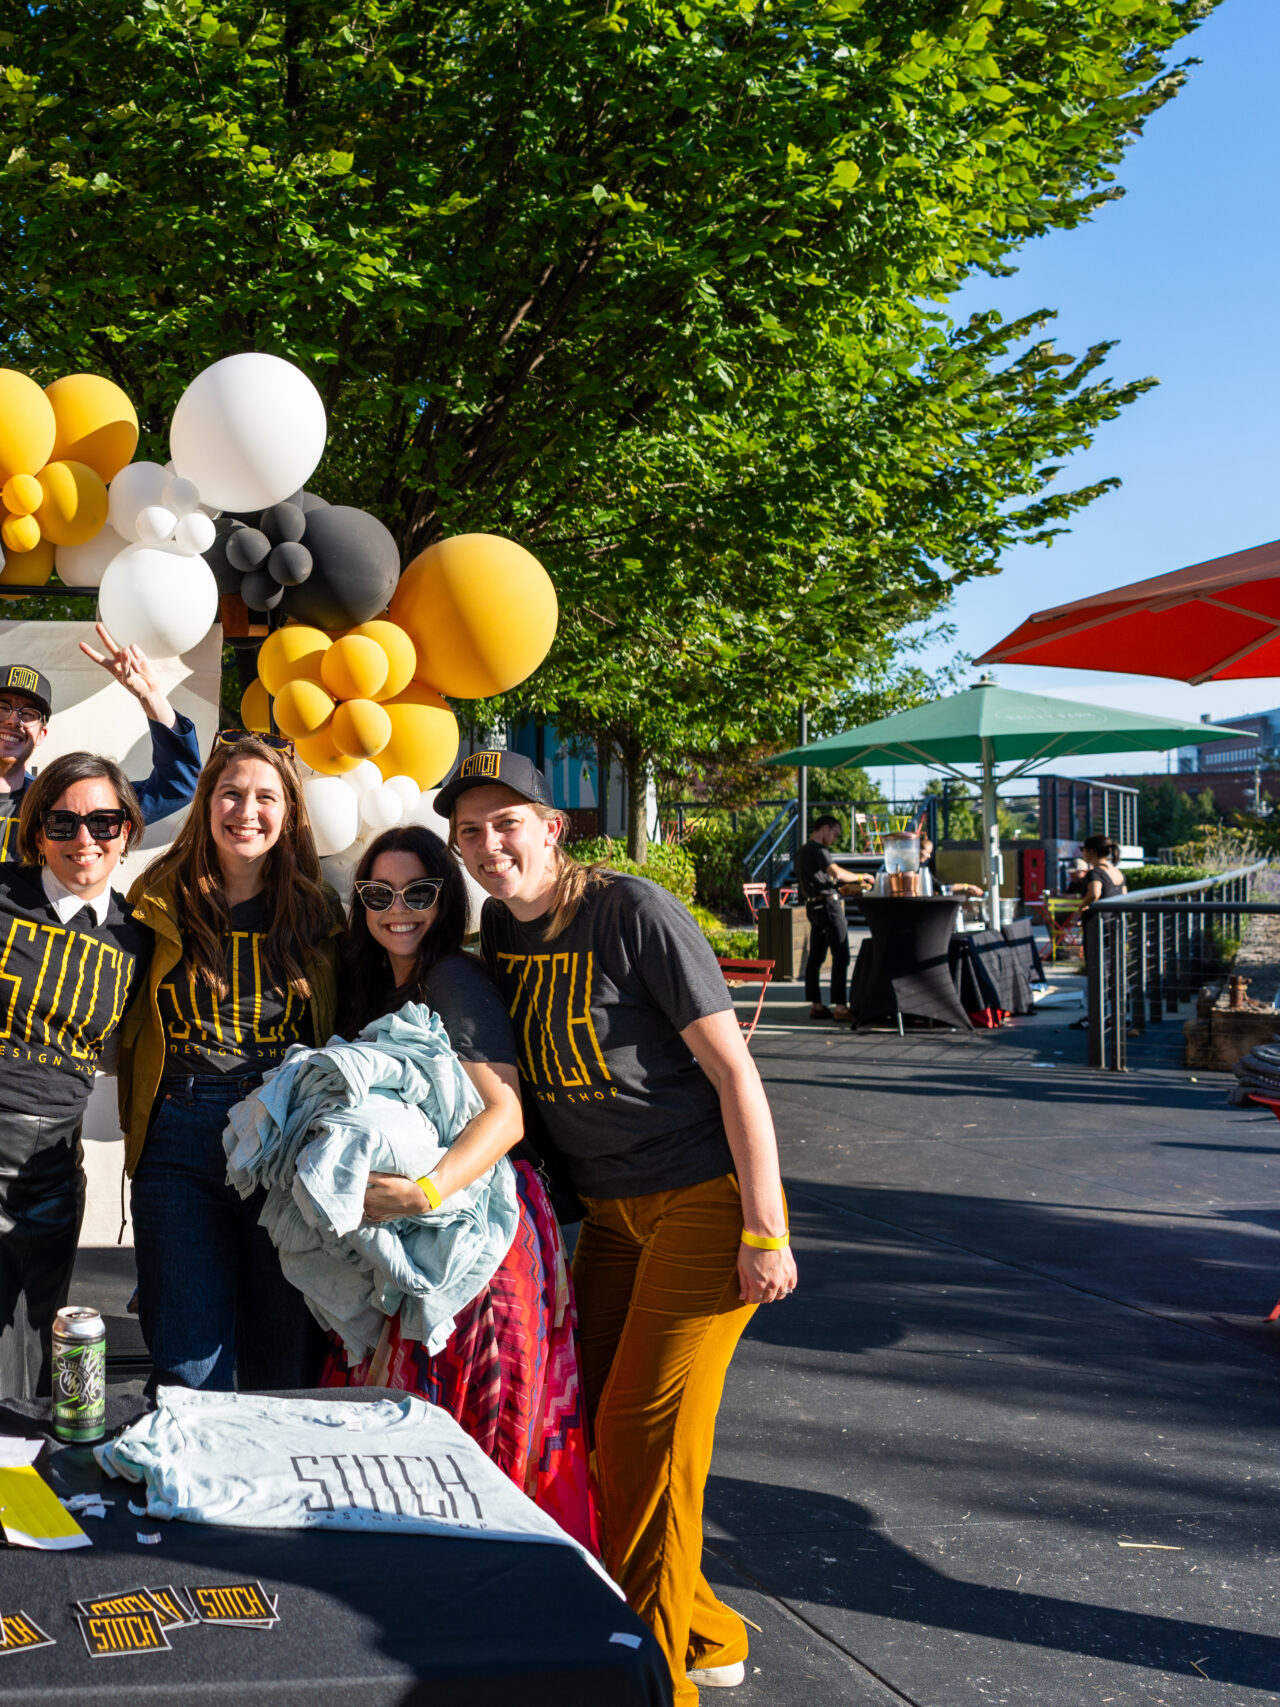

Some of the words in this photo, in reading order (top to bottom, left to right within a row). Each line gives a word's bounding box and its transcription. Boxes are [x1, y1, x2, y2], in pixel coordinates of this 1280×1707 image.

[12, 669, 36, 690] STITCH
[497, 951, 612, 1087] TITCH
[170, 1045, 242, 1057] DESIGN
[257, 1047, 288, 1058] SHO
[567, 1087, 618, 1103] SHOP
[290, 1454, 483, 1519] STITCH
[196, 1586, 267, 1617] STITCH
[88, 1616, 158, 1650] STITCH
